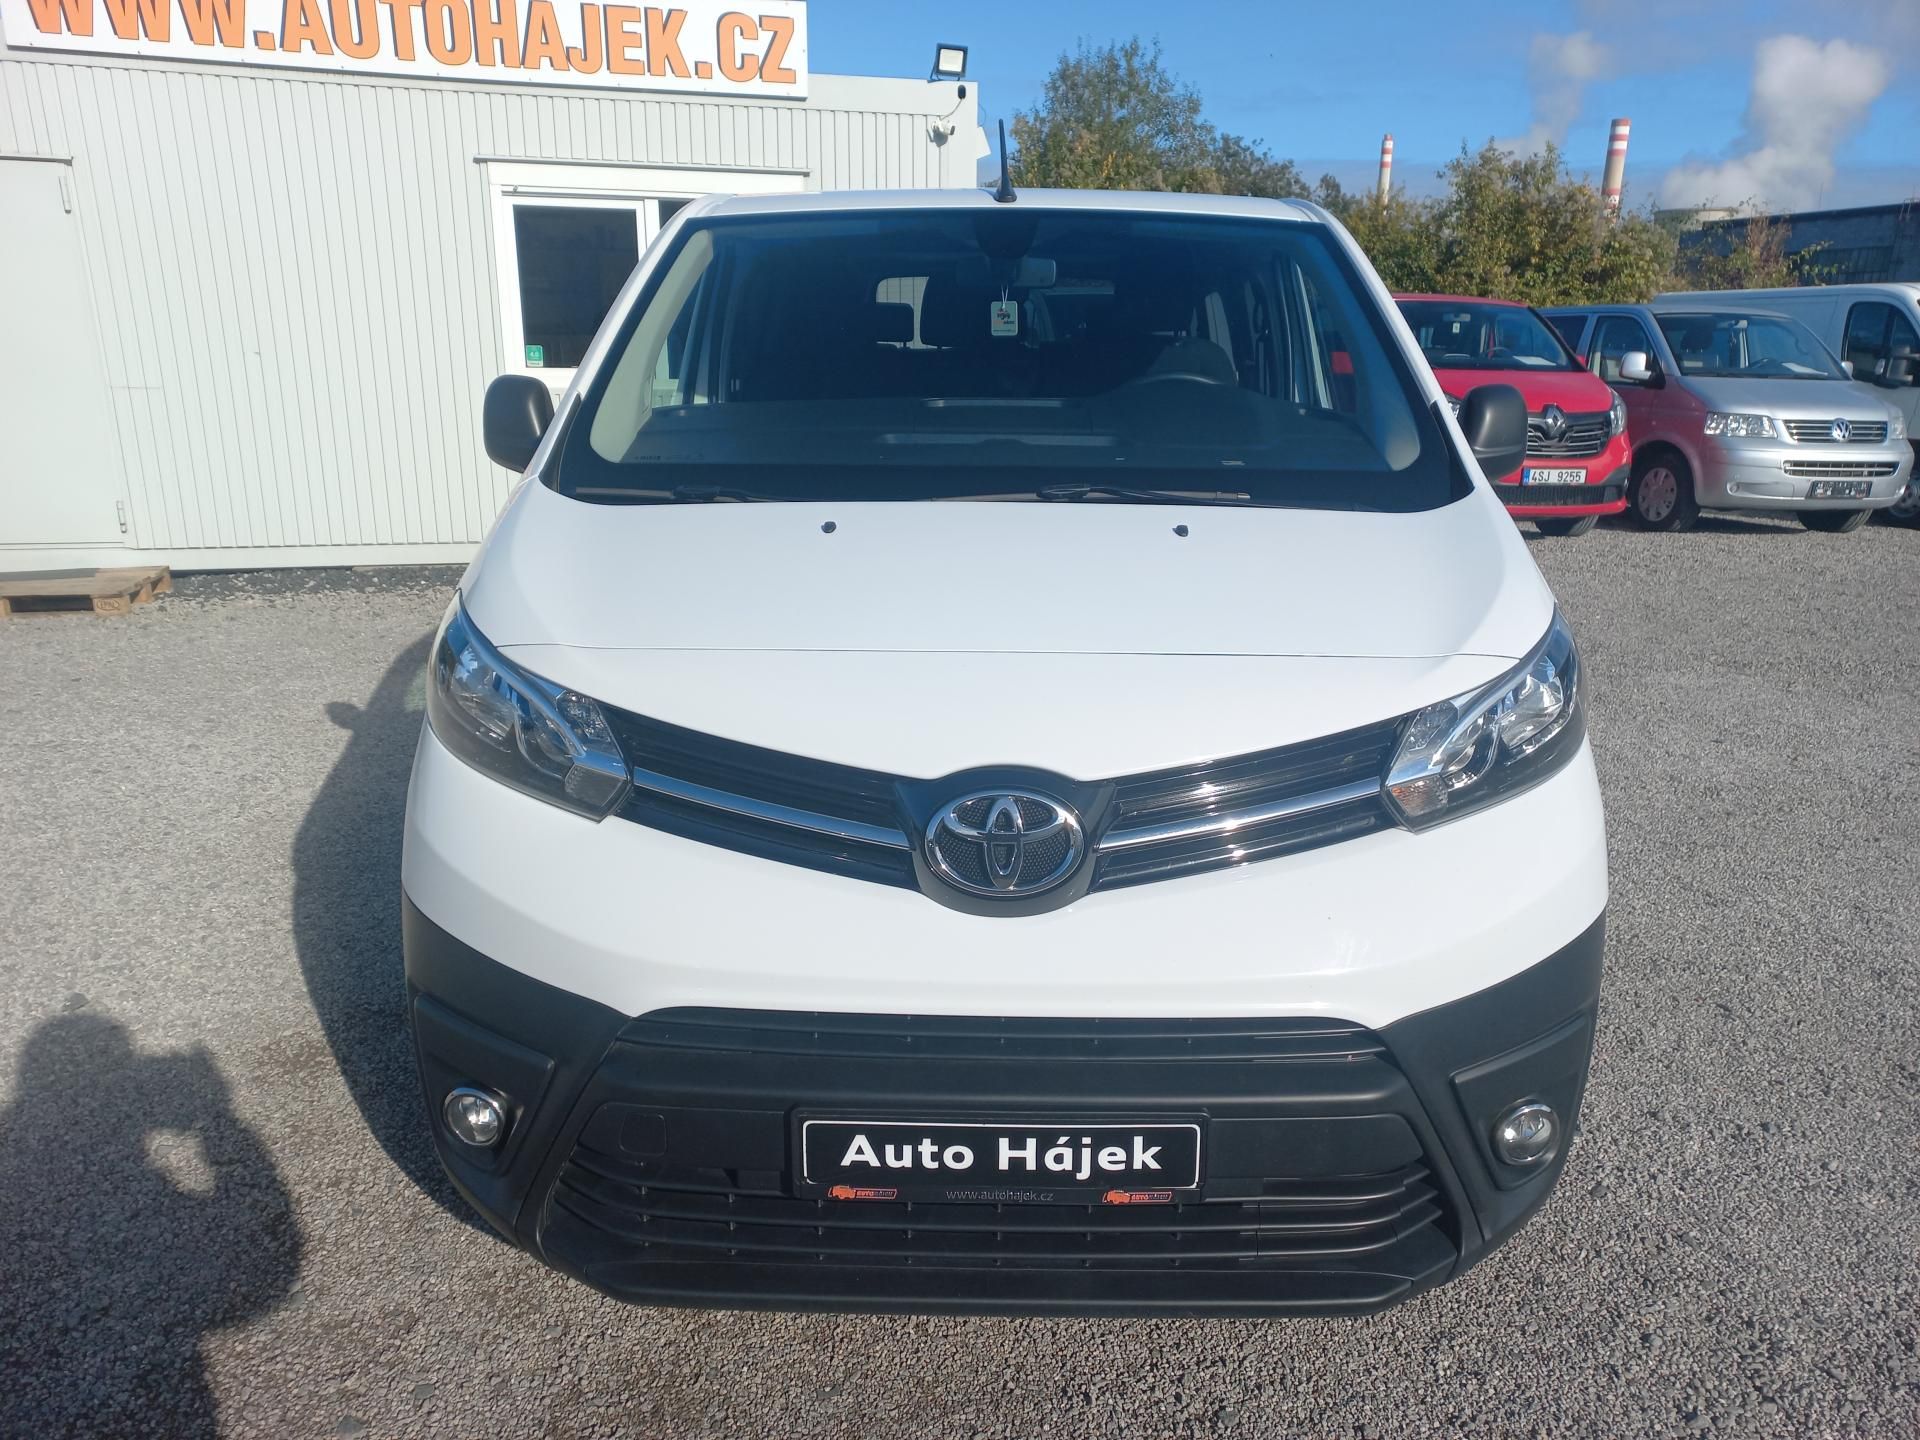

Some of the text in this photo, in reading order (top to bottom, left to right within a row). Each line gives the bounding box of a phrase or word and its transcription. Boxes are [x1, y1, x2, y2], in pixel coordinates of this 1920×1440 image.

[1531, 470, 1551, 482] 4SJ
[1557, 470, 1582, 483] 9255
[840, 1133, 1163, 1180] Auto Hájek
